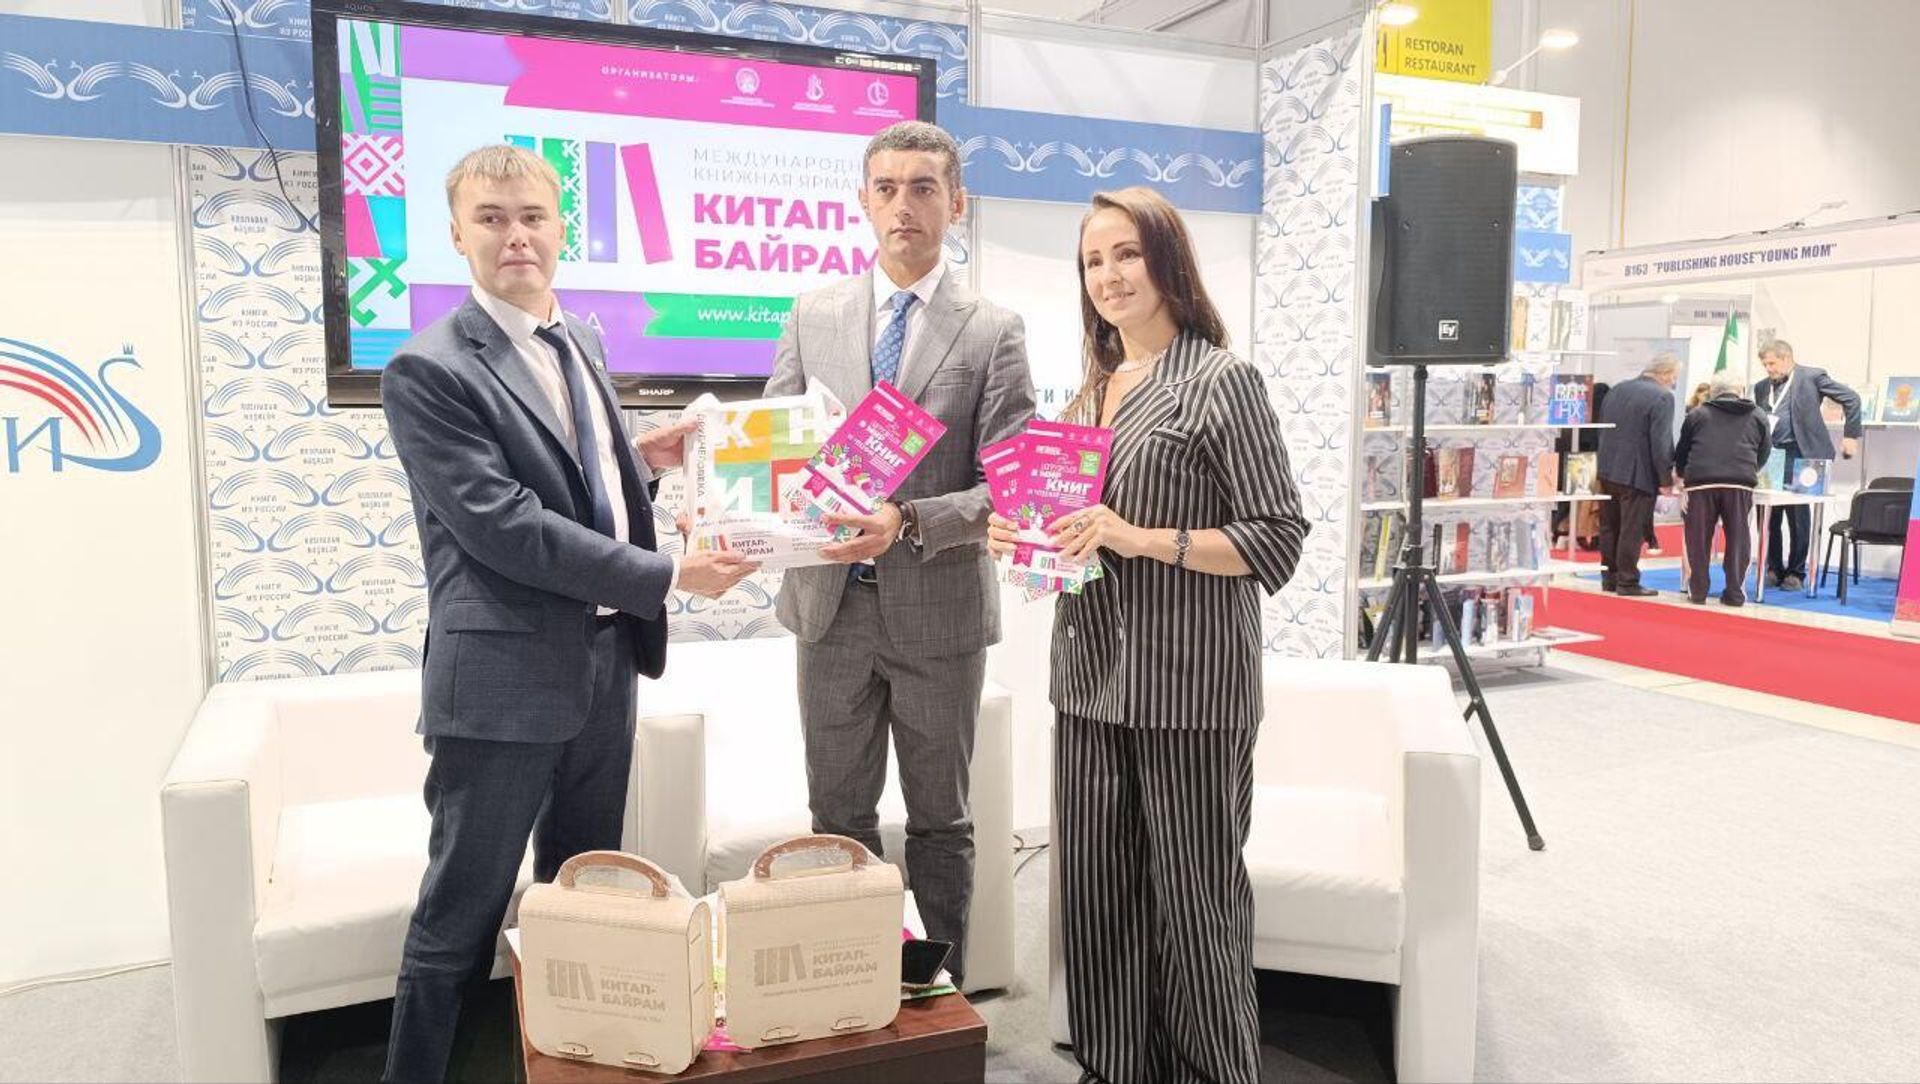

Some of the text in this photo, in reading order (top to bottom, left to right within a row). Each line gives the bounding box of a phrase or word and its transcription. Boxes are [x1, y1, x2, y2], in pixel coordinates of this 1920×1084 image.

[1405, 37, 1464, 56] RESTORAN
[1405, 56, 1477, 76] RESTAURANT
[694, 167, 792, 188] КНИЖНАЯ
[694, 193, 861, 231] КИТАП-
[694, 233, 879, 275] БАЙРАМ
[865, 436, 907, 468] КНИГ
[1045, 478, 1094, 496] КНИГ
[731, 539, 769, 549] КИТАП-
[813, 949, 870, 966] КИТАП-
[813, 961, 877, 979] БАЙРАМ
[600, 978, 657, 996] КИТАП-
[600, 993, 665, 1011] БАЙРАМ
